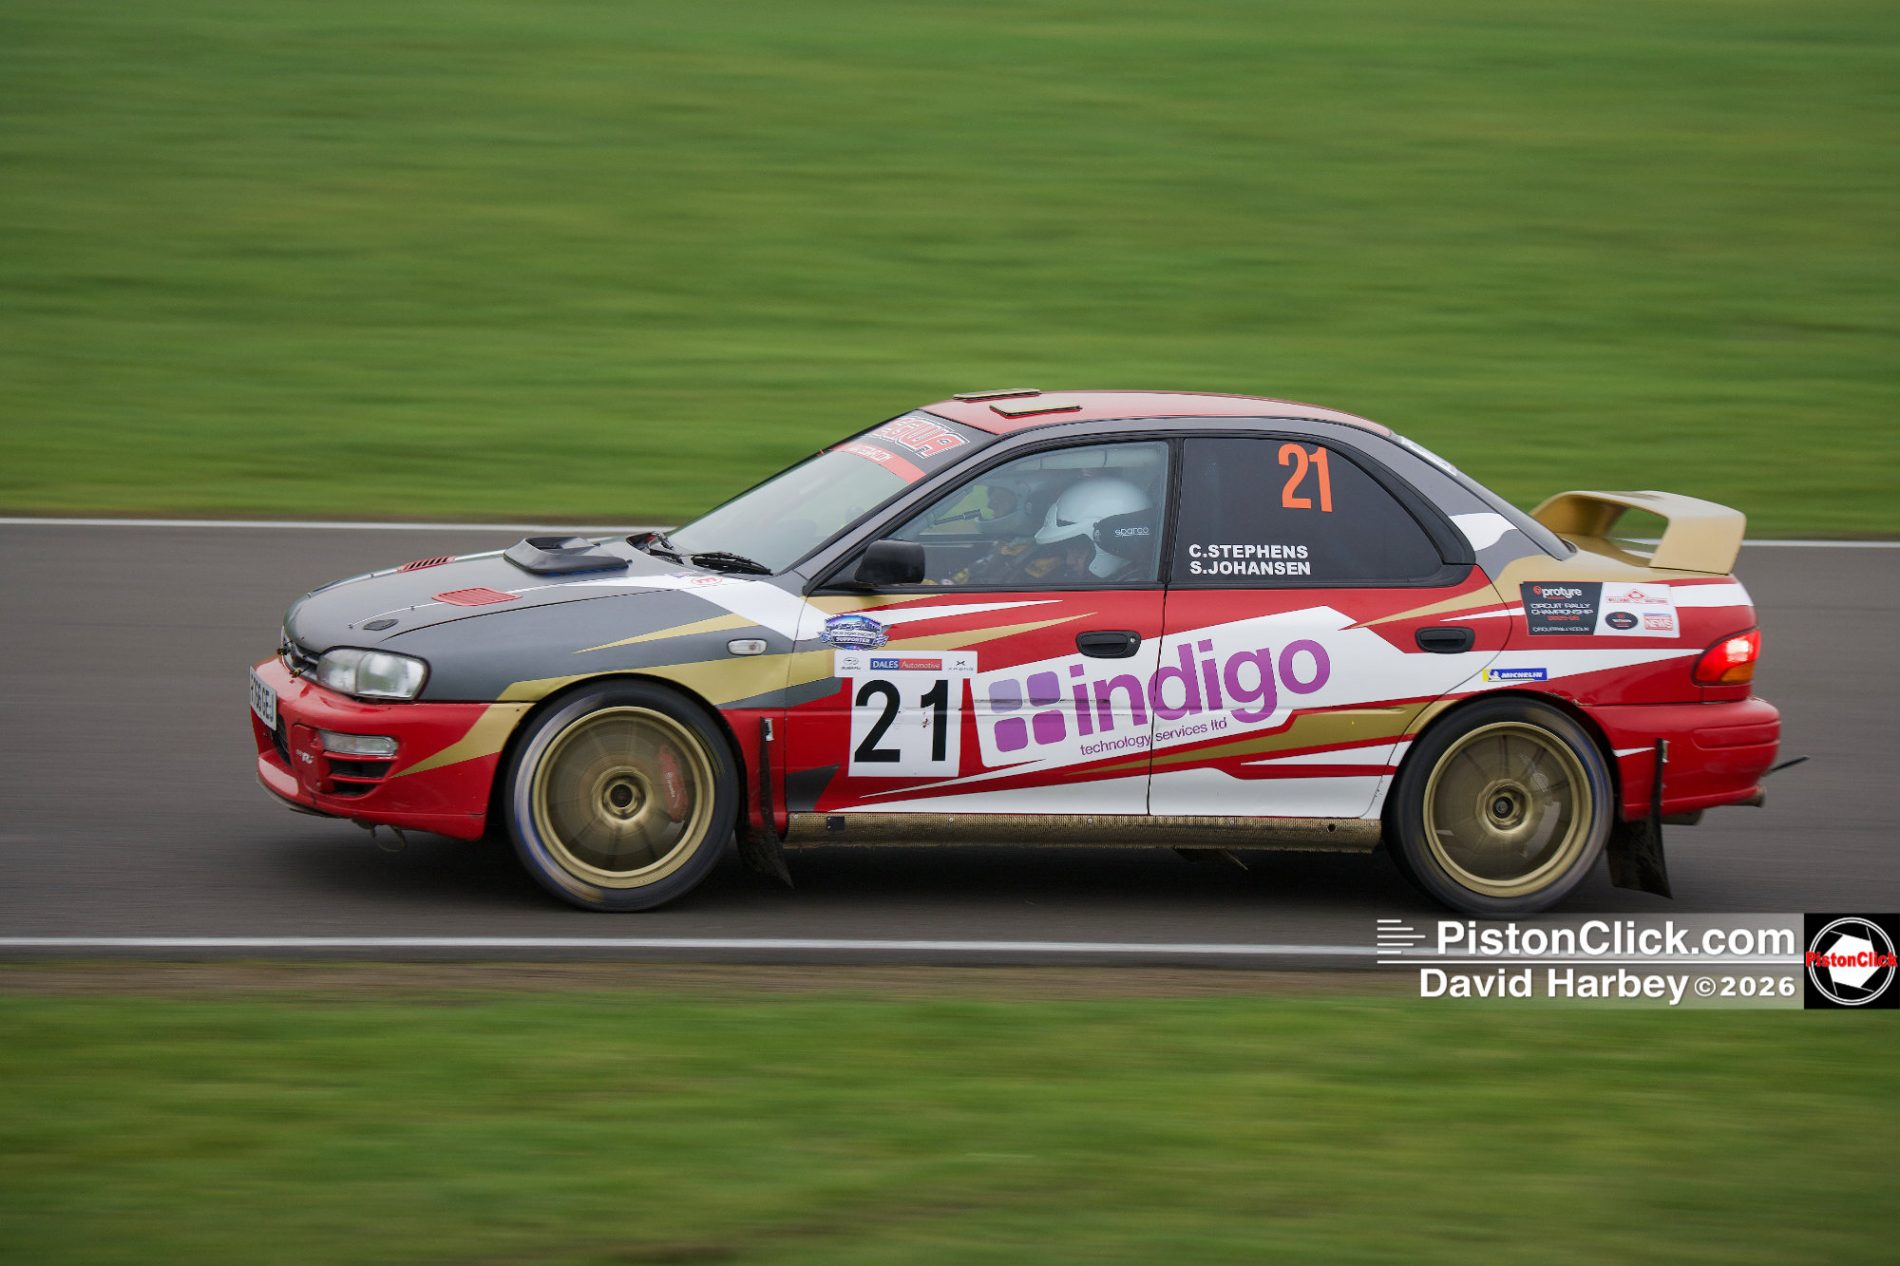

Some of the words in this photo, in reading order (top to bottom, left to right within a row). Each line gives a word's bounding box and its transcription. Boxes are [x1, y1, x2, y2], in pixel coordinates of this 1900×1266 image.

[1278, 443, 1333, 513] 21
[1114, 526, 1150, 537] sparco
[1188, 544, 1309, 559] C.STEPHENS
[1189, 561, 1311, 576] S.JOHANSEN
[1542, 586, 1583, 599] protyre
[872, 660, 899, 669] DALES
[901, 660, 941, 669] Automotive
[1069, 638, 1331, 737] indigo
[853, 679, 949, 763] 21
[1080, 735, 1152, 756] technology
[1155, 723, 1208, 743] services
[1211, 716, 1228, 730] ltd
